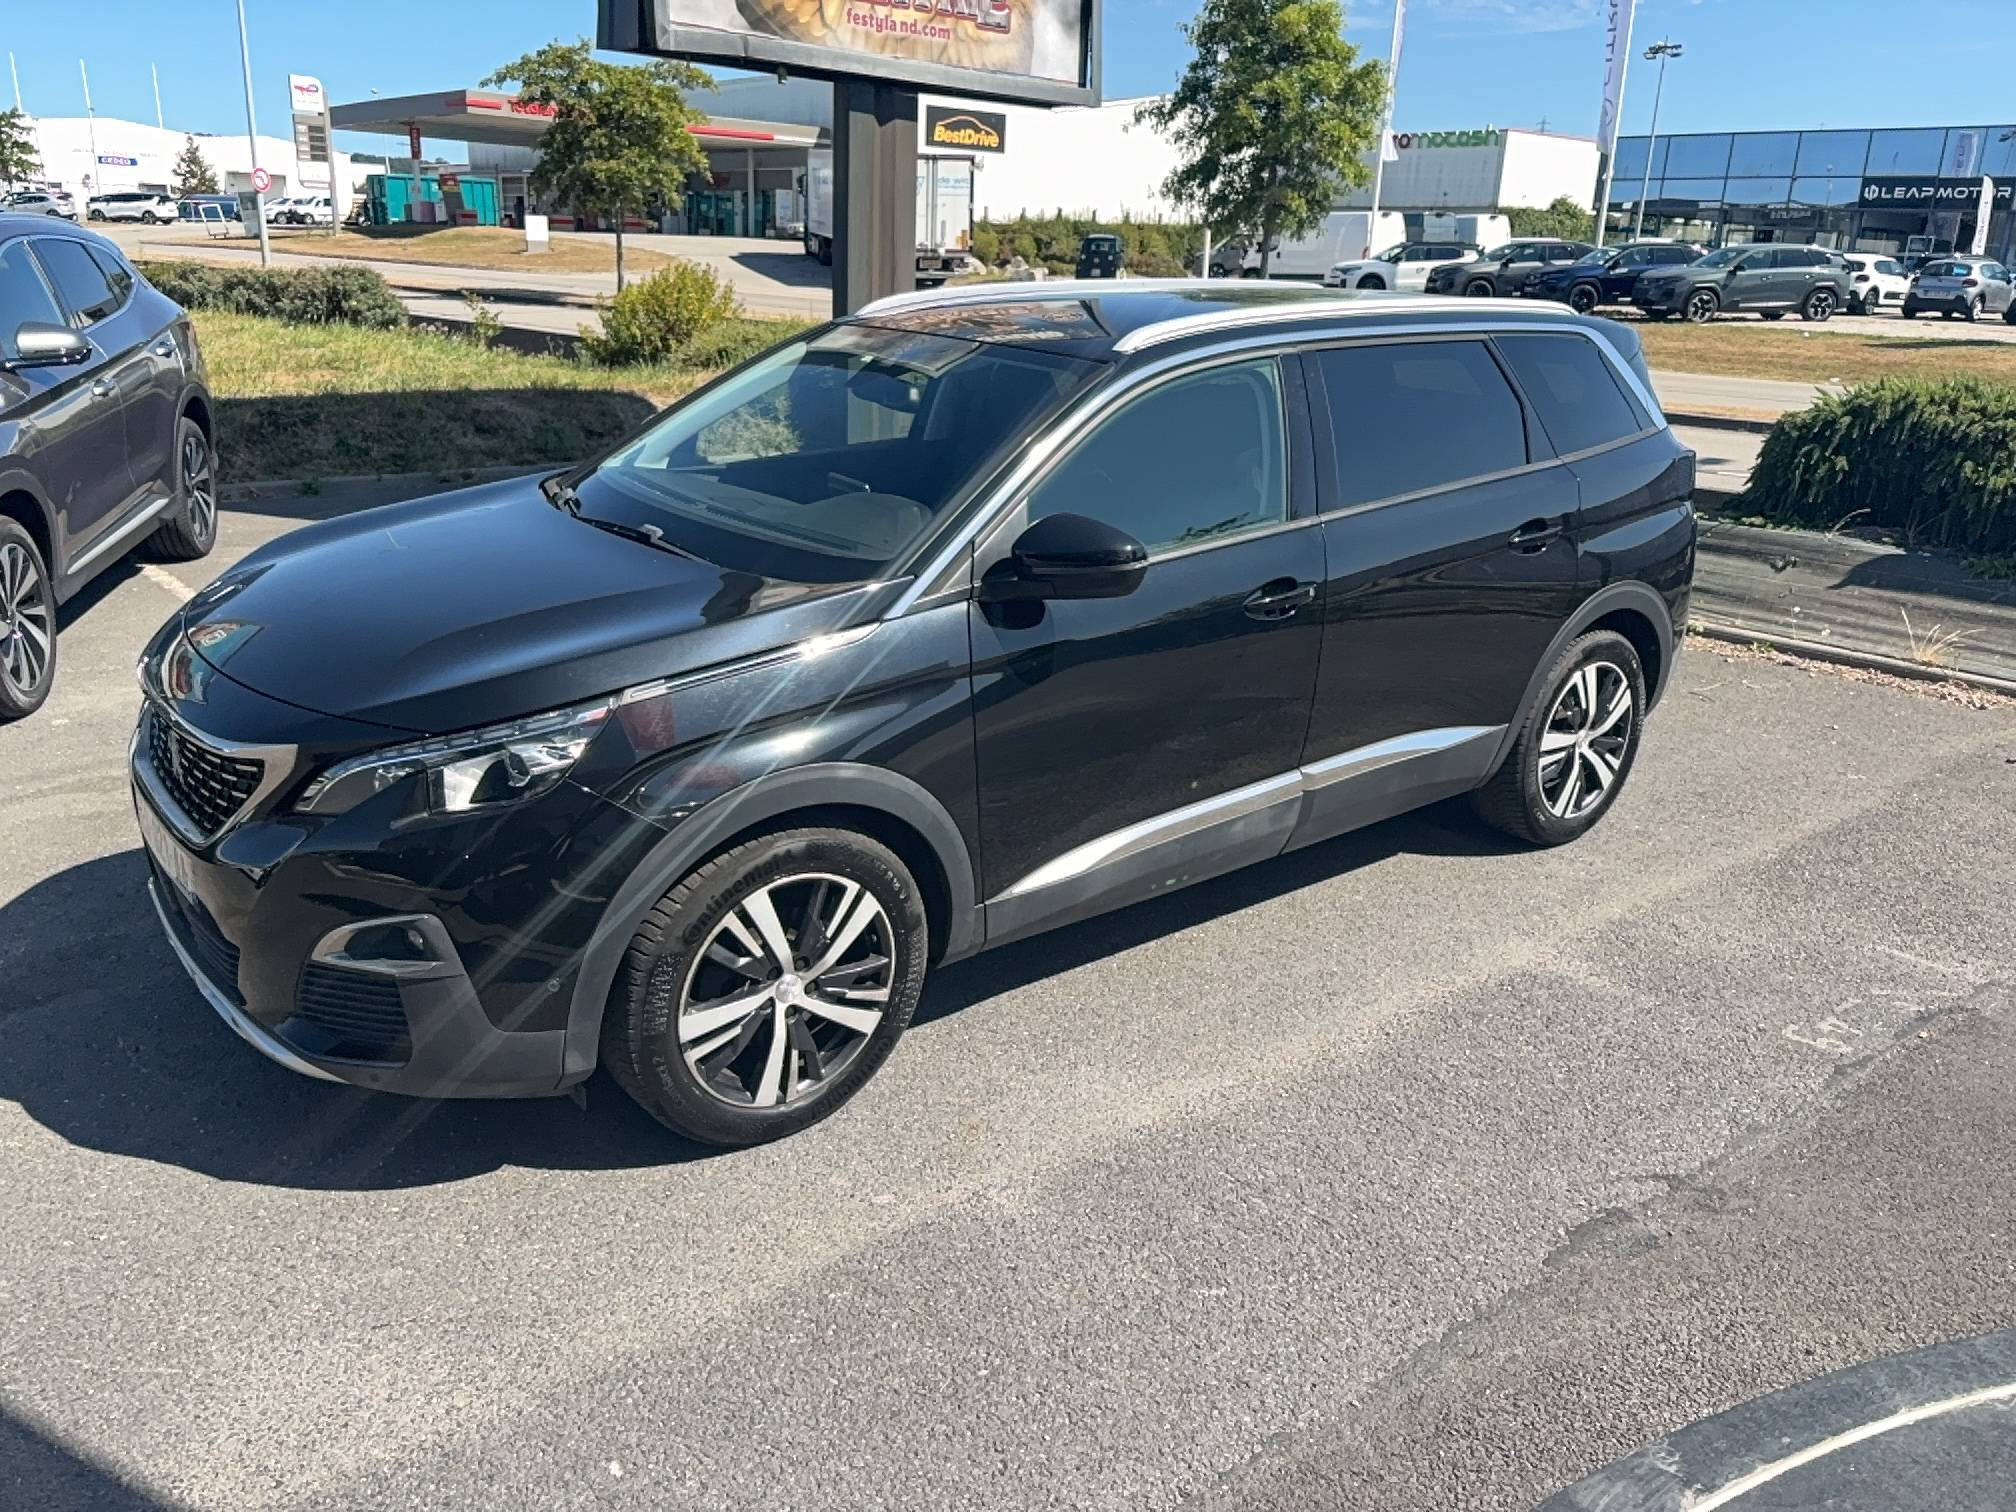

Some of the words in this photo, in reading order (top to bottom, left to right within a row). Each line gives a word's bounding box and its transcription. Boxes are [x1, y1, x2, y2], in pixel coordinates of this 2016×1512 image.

[846, 8, 951, 40] festyland.com
[934, 125, 999, 148] BestDrive
[1881, 186, 2012, 199] LEAPMOTR
